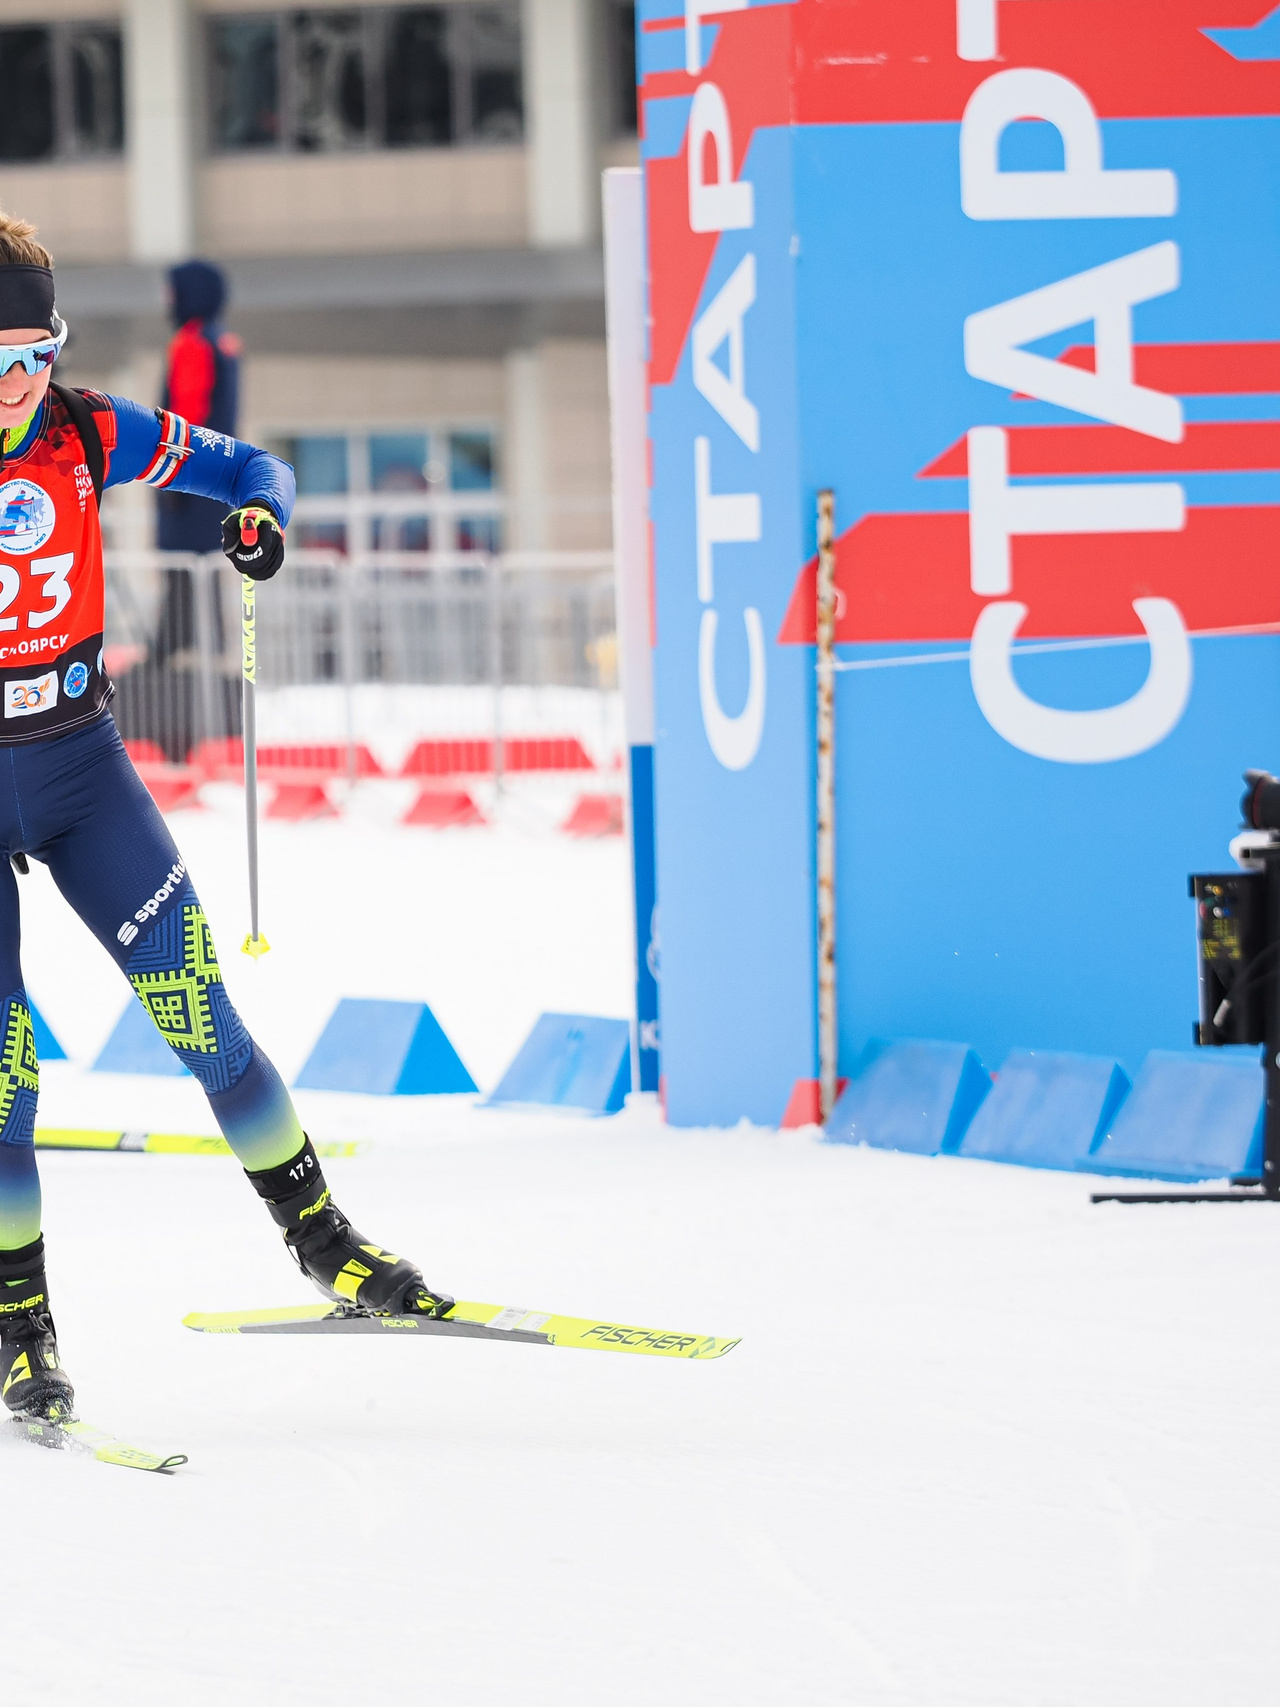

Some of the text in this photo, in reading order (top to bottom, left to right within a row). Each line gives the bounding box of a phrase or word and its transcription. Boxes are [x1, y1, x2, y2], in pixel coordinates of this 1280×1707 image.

[242, 573, 256, 685] NEWAY
[299, 1187, 331, 1221] FISCH
[381, 1319, 419, 1328] FISCHER
[580, 1325, 697, 1352] FISCHER
